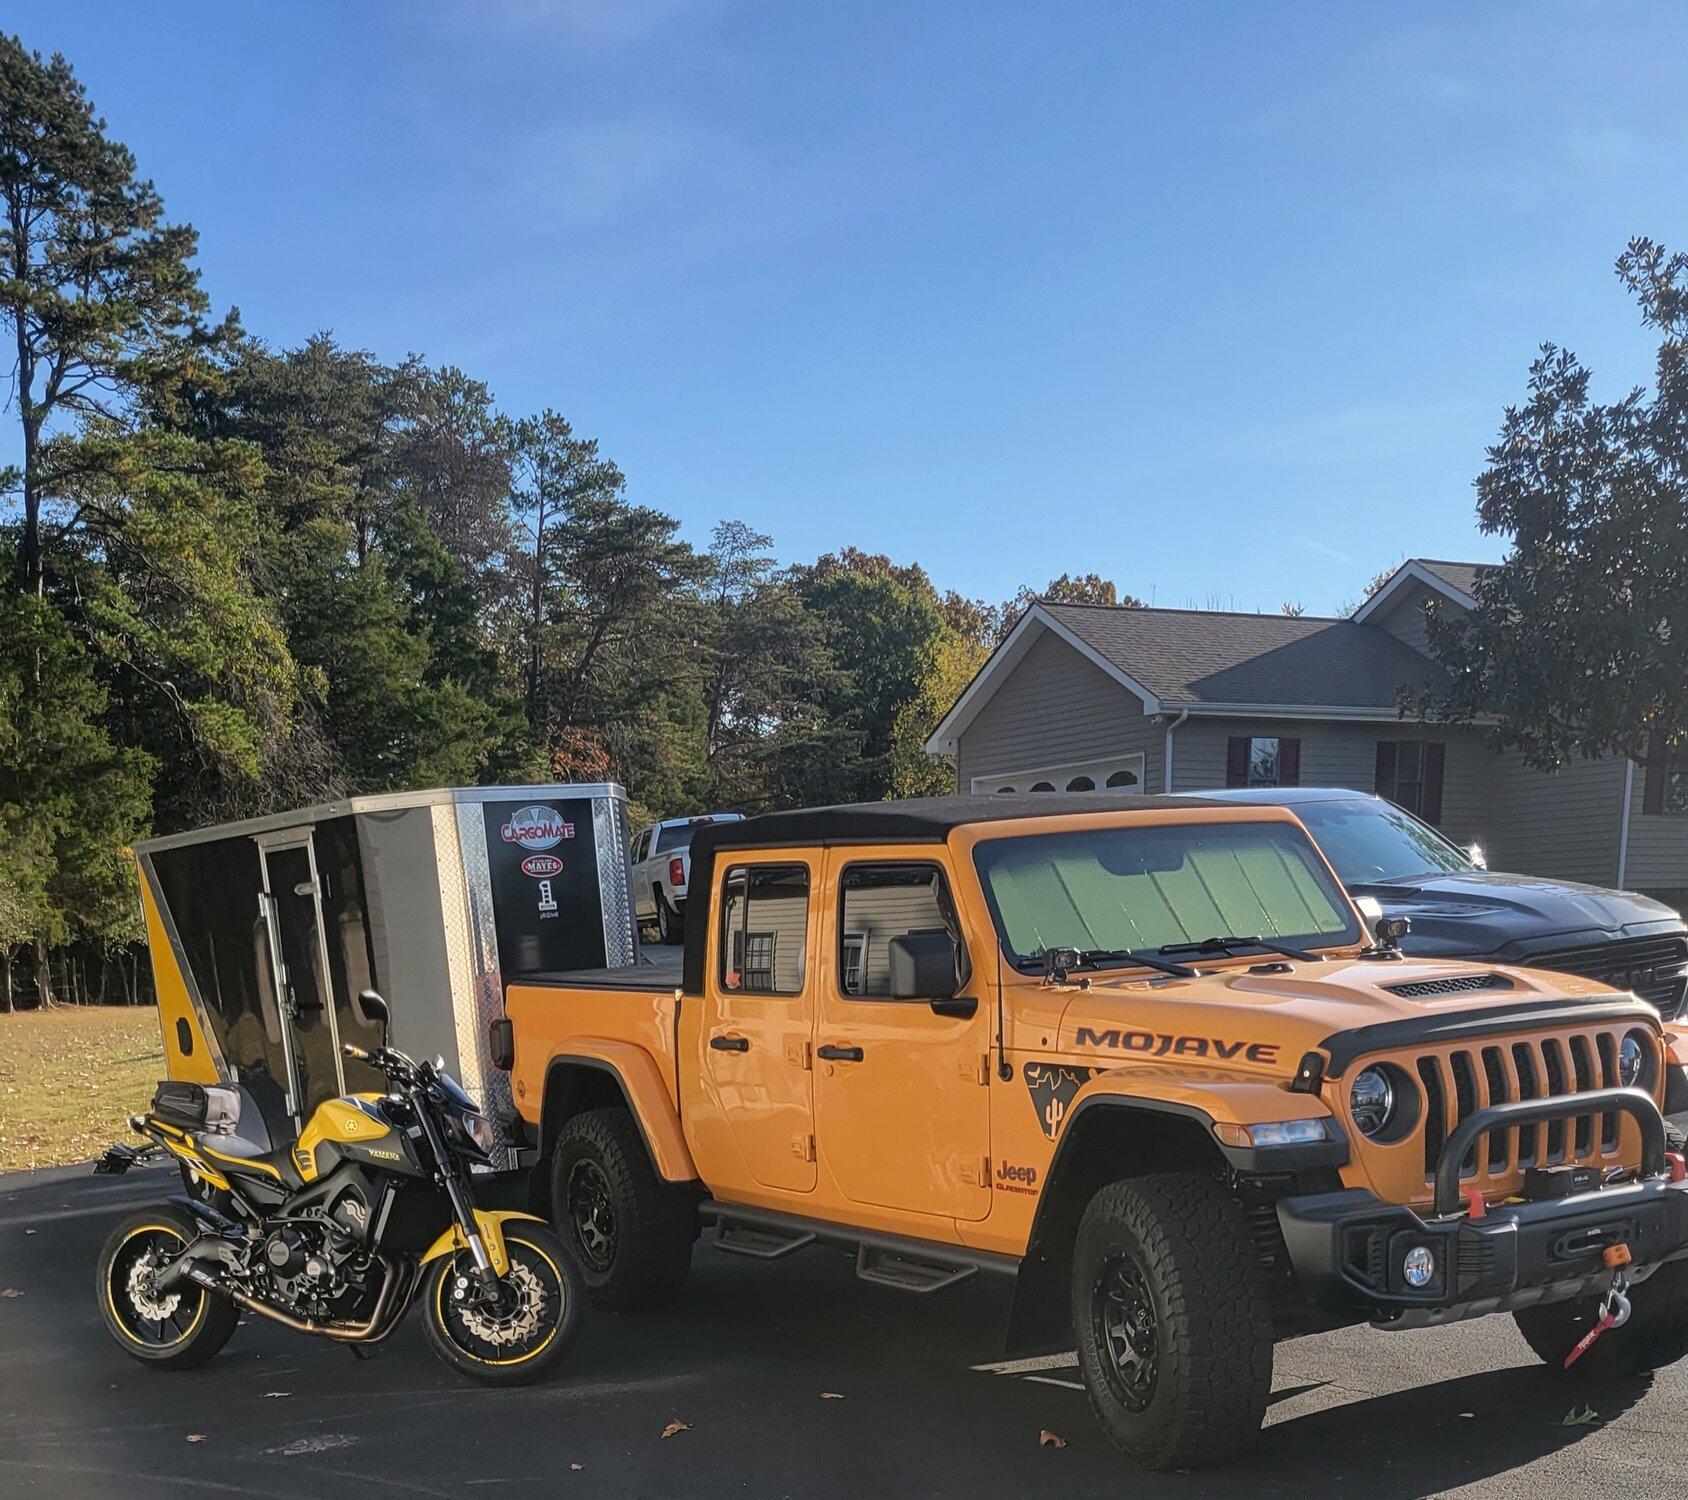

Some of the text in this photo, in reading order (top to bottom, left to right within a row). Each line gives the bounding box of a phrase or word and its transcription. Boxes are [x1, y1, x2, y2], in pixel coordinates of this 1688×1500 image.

[527, 862, 558, 870] MAYES
[1075, 1027, 1281, 1065] MOJAVE
[368, 1148, 401, 1161] YAMAHA
[997, 1160, 1037, 1186] Jeep
